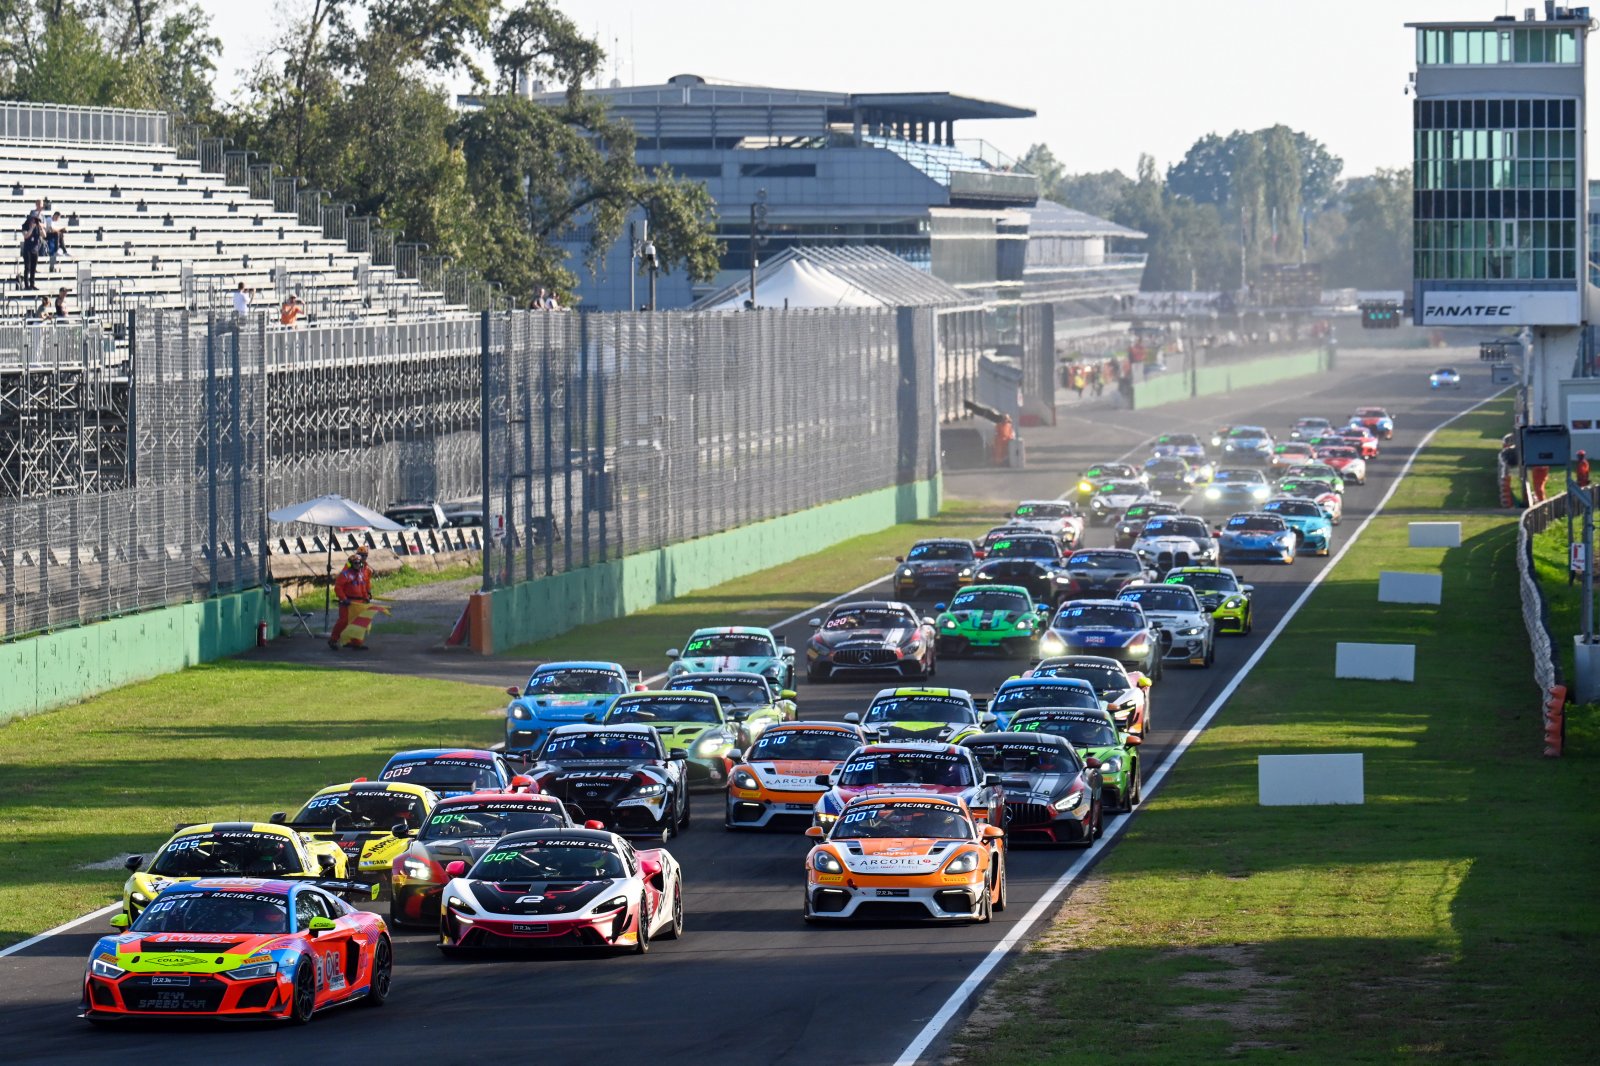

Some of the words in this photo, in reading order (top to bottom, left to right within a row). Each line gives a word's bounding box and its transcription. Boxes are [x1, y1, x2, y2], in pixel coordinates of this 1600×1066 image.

[1425, 306, 1512, 316] FANATEC
[826, 618, 848, 628] 020
[530, 676, 554, 687] 019
[1071, 687, 1089, 695] CLUB
[944, 698, 964, 706] CLUB
[998, 692, 1024, 703] 014
[614, 705, 639, 715] 013
[872, 703, 898, 715] 017
[1086, 717, 1107, 725] CLUB
[1014, 722, 1040, 733] 012
[837, 731, 858, 740] CLUB
[547, 740, 576, 752] 011
[759, 736, 787, 748] 010
[1037, 746, 1059, 754] CLUB
[845, 762, 876, 773] 006
[383, 767, 413, 780] 009
[556, 772, 634, 780] JOULIE
[308, 797, 339, 809] 003
[934, 805, 960, 813] CLUB
[431, 815, 464, 825] 004
[844, 811, 877, 824] 007
[263, 834, 290, 842] CLUB
[167, 840, 200, 852] 005
[483, 851, 518, 863] 002
[256, 895, 286, 905] CLUB
[151, 900, 189, 913] 001
[243, 956, 272, 964] PIRELLI
[138, 1000, 179, 1008] SPEED
